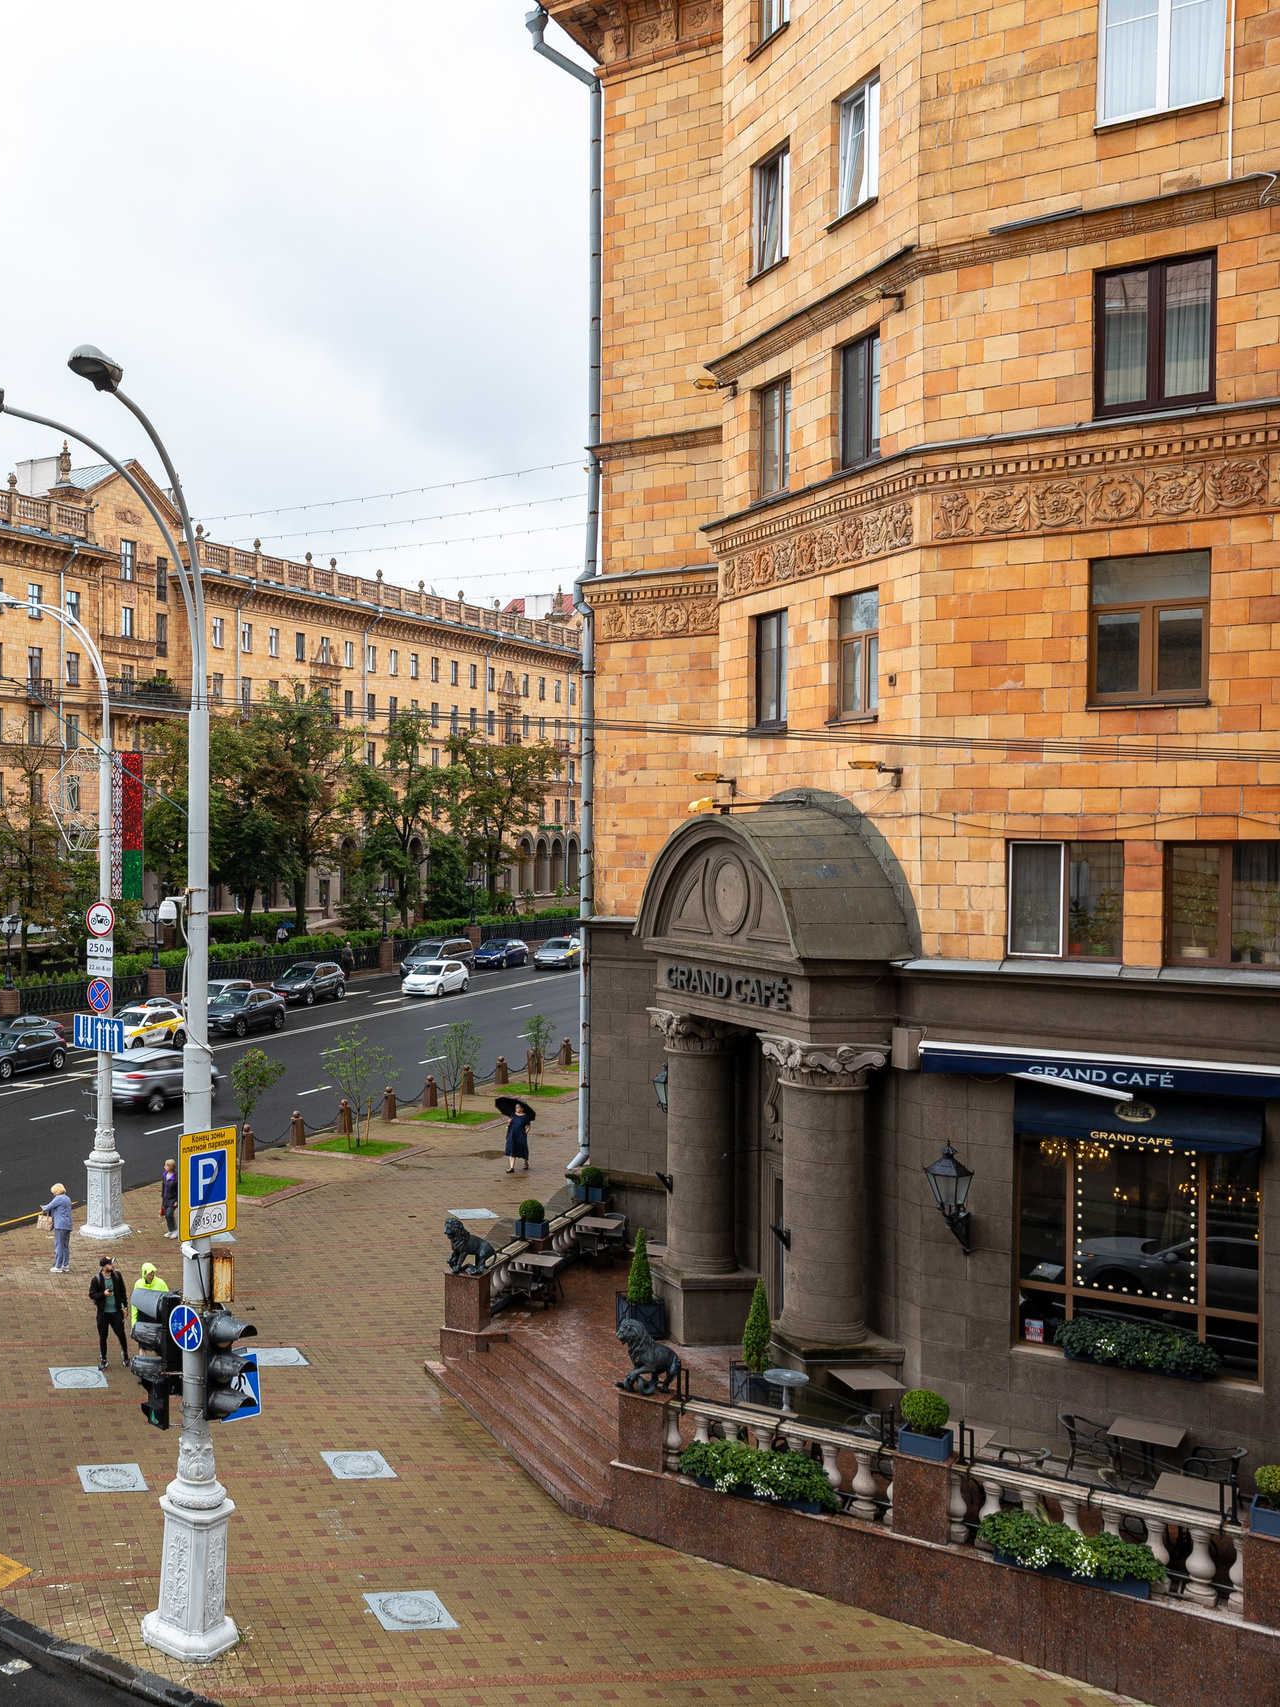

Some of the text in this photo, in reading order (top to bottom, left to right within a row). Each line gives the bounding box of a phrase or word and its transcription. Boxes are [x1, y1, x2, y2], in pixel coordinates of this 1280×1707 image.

[89, 943, 104, 953] 250
[666, 964, 792, 1012] GRAND CAFÉ
[1028, 1065, 1174, 1088] GRAND CAFÉ
[191, 1131, 226, 1144] Конец зоны
[1090, 1130, 1173, 1147] GRAND CAFÉ
[182, 1138, 235, 1154] платной парковки
[198, 1157, 219, 1201] P
[202, 1215, 210, 1226] 15
[212, 1212, 223, 1224] 20
